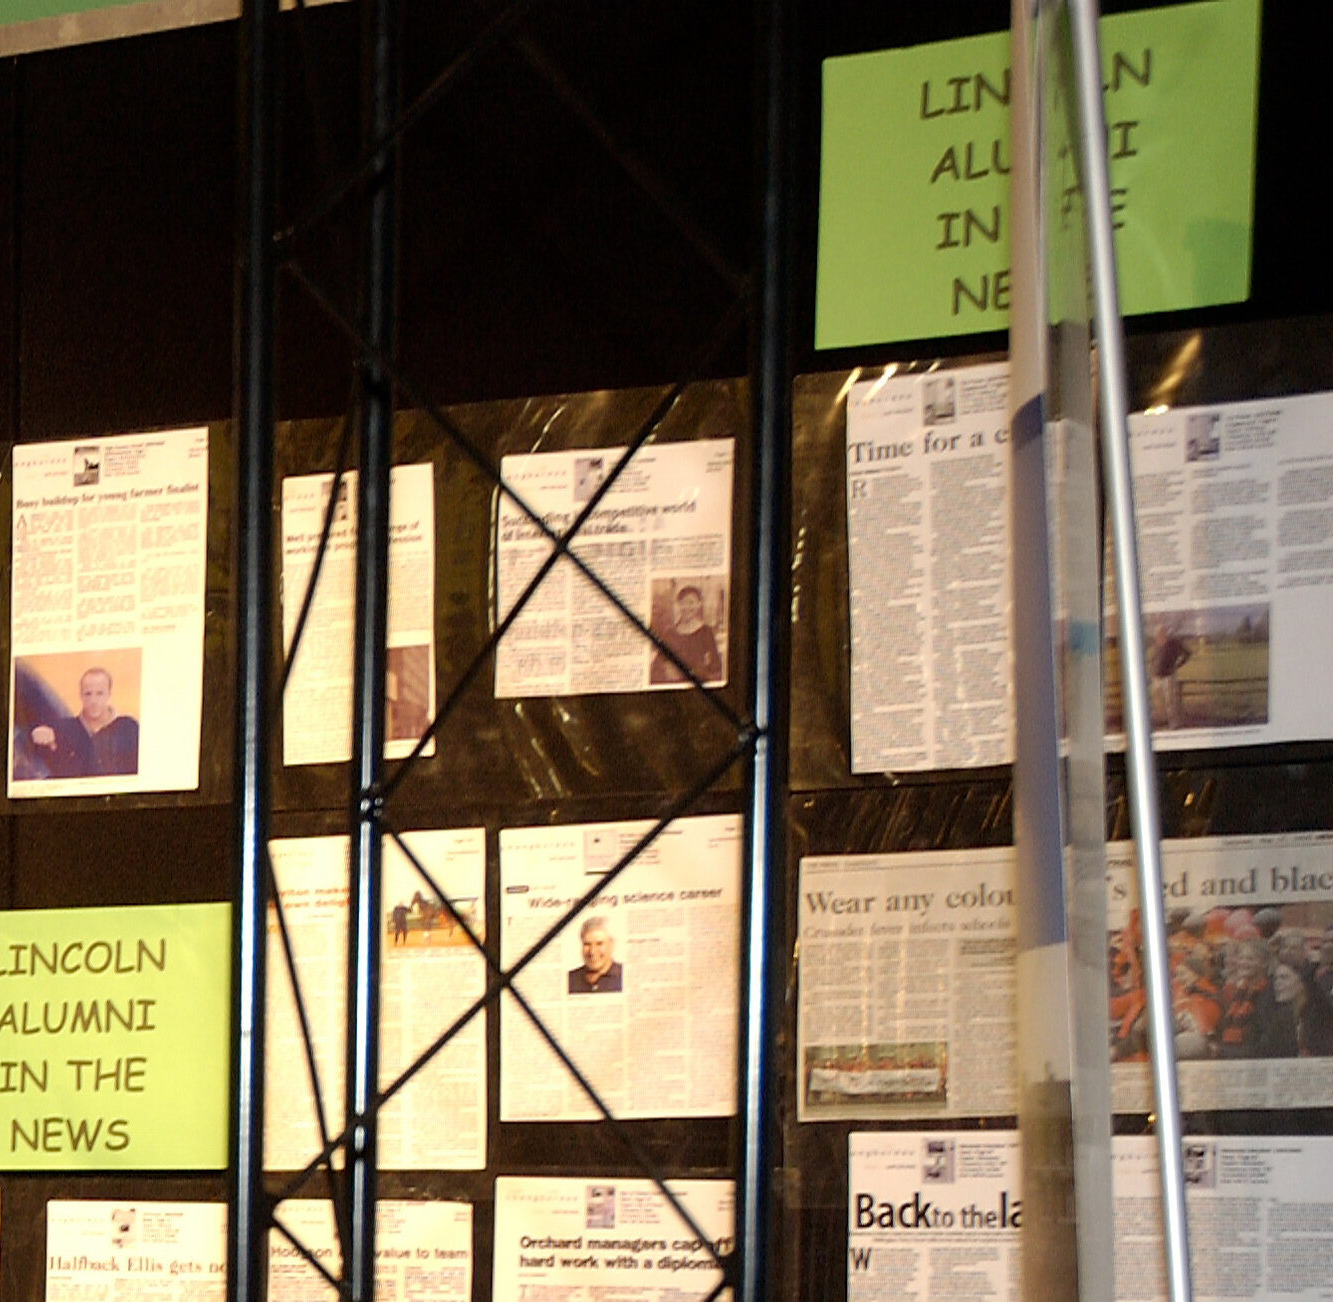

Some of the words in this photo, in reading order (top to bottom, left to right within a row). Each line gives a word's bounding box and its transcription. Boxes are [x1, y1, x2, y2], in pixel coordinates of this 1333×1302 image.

[920, 48, 1152, 120] LINN
[931, 120, 1140, 184] ALUI
[936, 205, 1001, 250] IN
[849, 440, 913, 464] Time
[923, 430, 962, 455] for
[969, 431, 984, 448] a
[803, 890, 878, 915] Wear
[885, 893, 935, 917] any
[1200, 865, 1258, 896] and
[1270, 863, 1333, 894] blac
[66, 1057, 148, 1093] THE
[10, 1117, 131, 1154] NEWS
[855, 1191, 933, 1230] Back
[933, 1205, 956, 1230] to
[959, 1203, 998, 1230] the
[999, 1189, 1023, 1231] la
[519, 1236, 583, 1250] Orchard
[587, 1238, 668, 1253] managers
[519, 1255, 555, 1268] hard
[560, 1255, 599, 1268] work
[604, 1255, 639, 1269] with
[643, 1259, 653, 1269] a
[48, 1255, 120, 1272] Halfback
[127, 1255, 163, 1273] Ellis
[169, 1259, 202, 1276] gets
